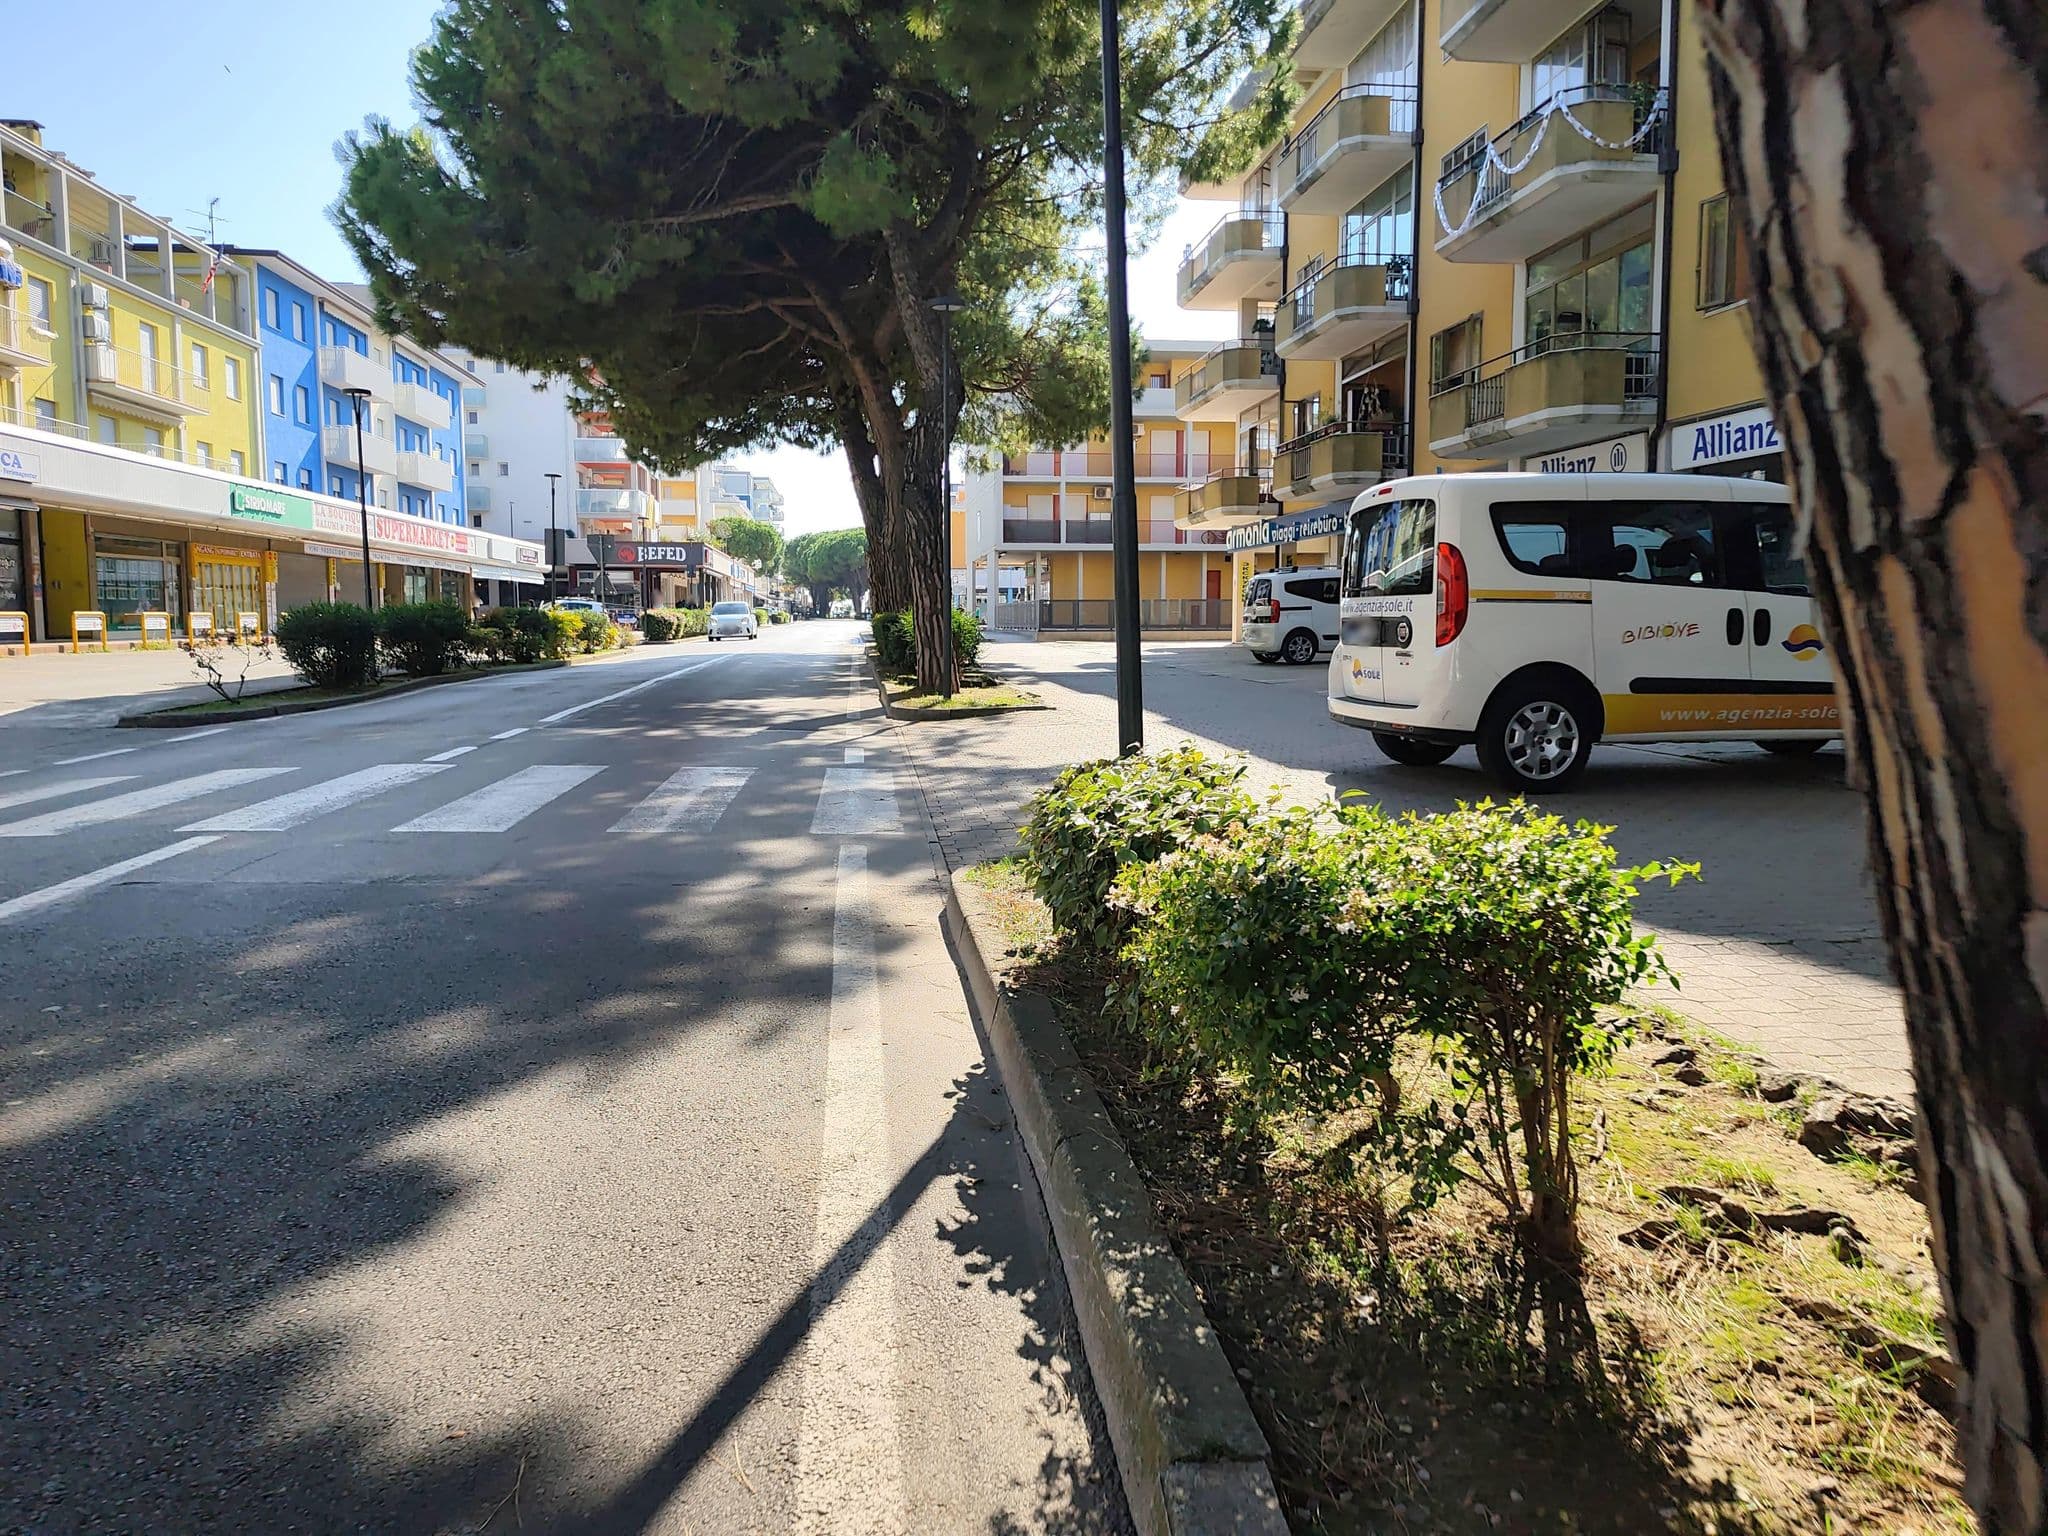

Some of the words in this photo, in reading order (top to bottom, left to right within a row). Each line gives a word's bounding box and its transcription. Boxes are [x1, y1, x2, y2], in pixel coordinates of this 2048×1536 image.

[1692, 419, 1779, 461] Allianz
[376, 517, 450, 549] SUPERMARKET
[1226, 519, 1270, 549] armonia
[637, 546, 687, 562] BEFED
[1363, 670, 1381, 680] SOLE
[1660, 705, 1841, 723] www.agenzia-sole
